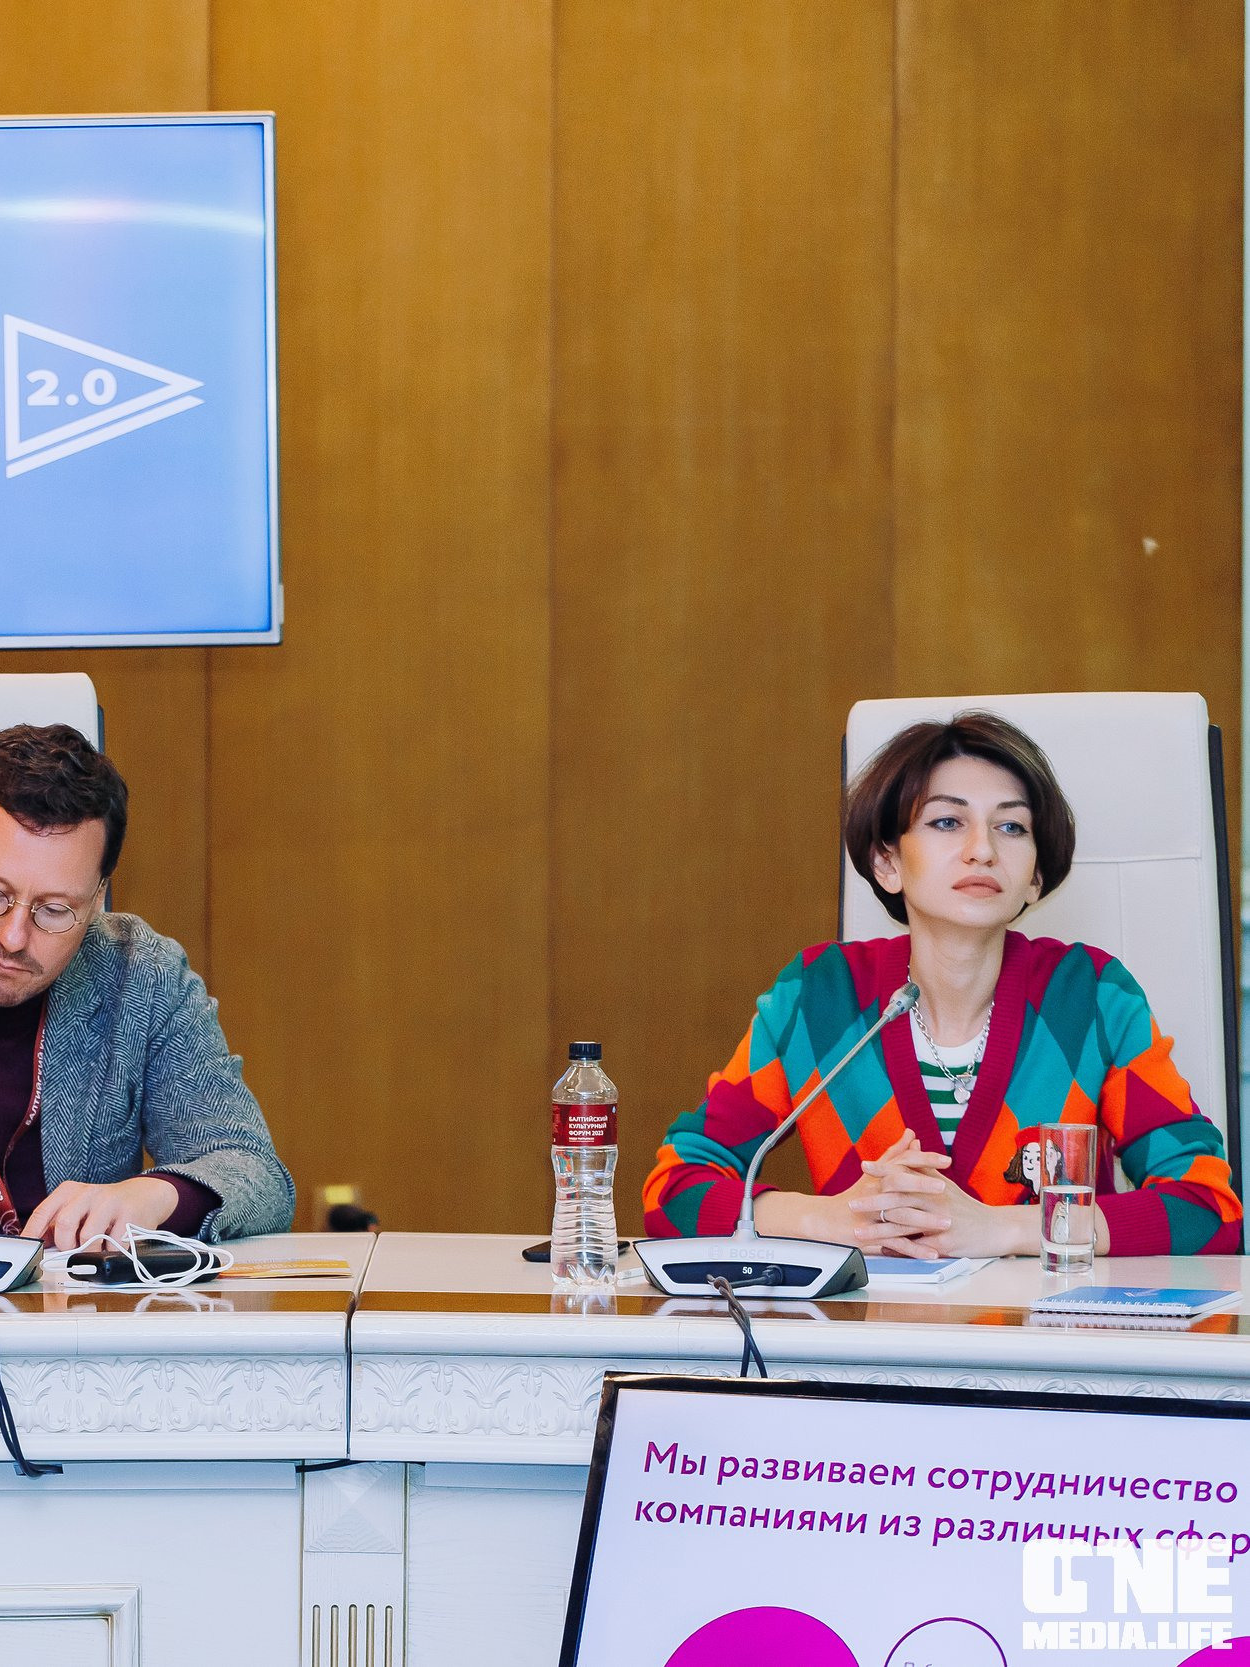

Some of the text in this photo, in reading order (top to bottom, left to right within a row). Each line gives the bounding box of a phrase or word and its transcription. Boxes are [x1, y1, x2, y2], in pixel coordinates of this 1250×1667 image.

[25, 368, 118, 406] 2.0
[729, 1248, 775, 1259] BOSCH
[742, 1266, 753, 1275] 50
[644, 1441, 1238, 1503] Мы развиваем сотрудничество
[635, 1500, 868, 1534] компаниями
[879, 1514, 921, 1537] из
[932, 1516, 1144, 1549] различных
